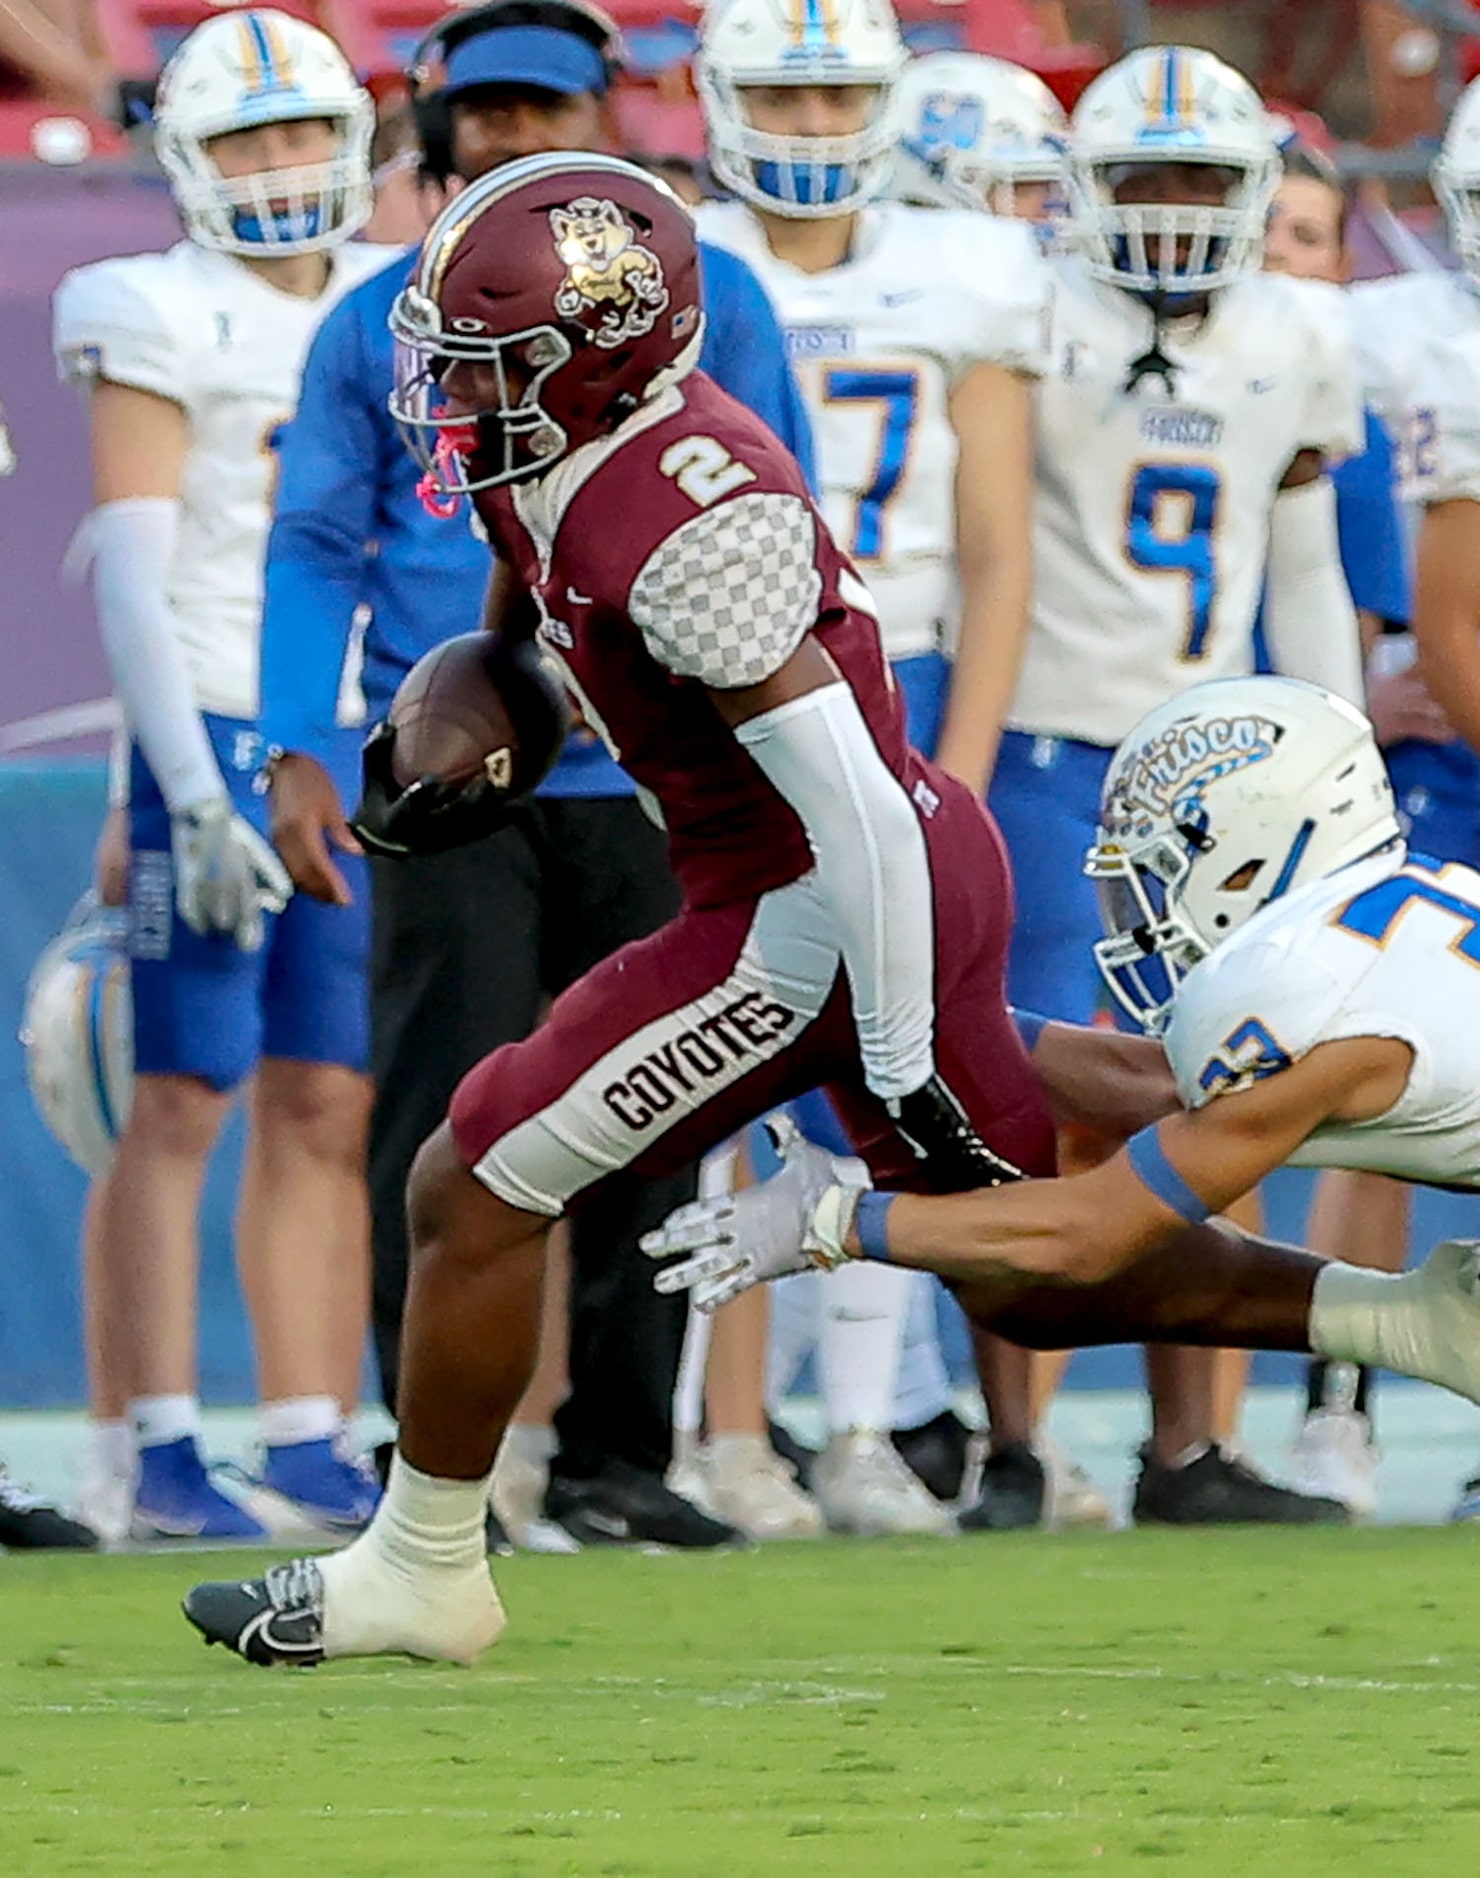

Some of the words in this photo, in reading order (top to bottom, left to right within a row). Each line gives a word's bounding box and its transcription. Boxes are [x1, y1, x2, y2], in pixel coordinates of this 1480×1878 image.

[659, 435, 757, 508] 2
[820, 360, 920, 567] 7
[1121, 458, 1222, 664] 9
[1128, 716, 1262, 817] Frisco
[603, 992, 794, 1132] COYOTES
